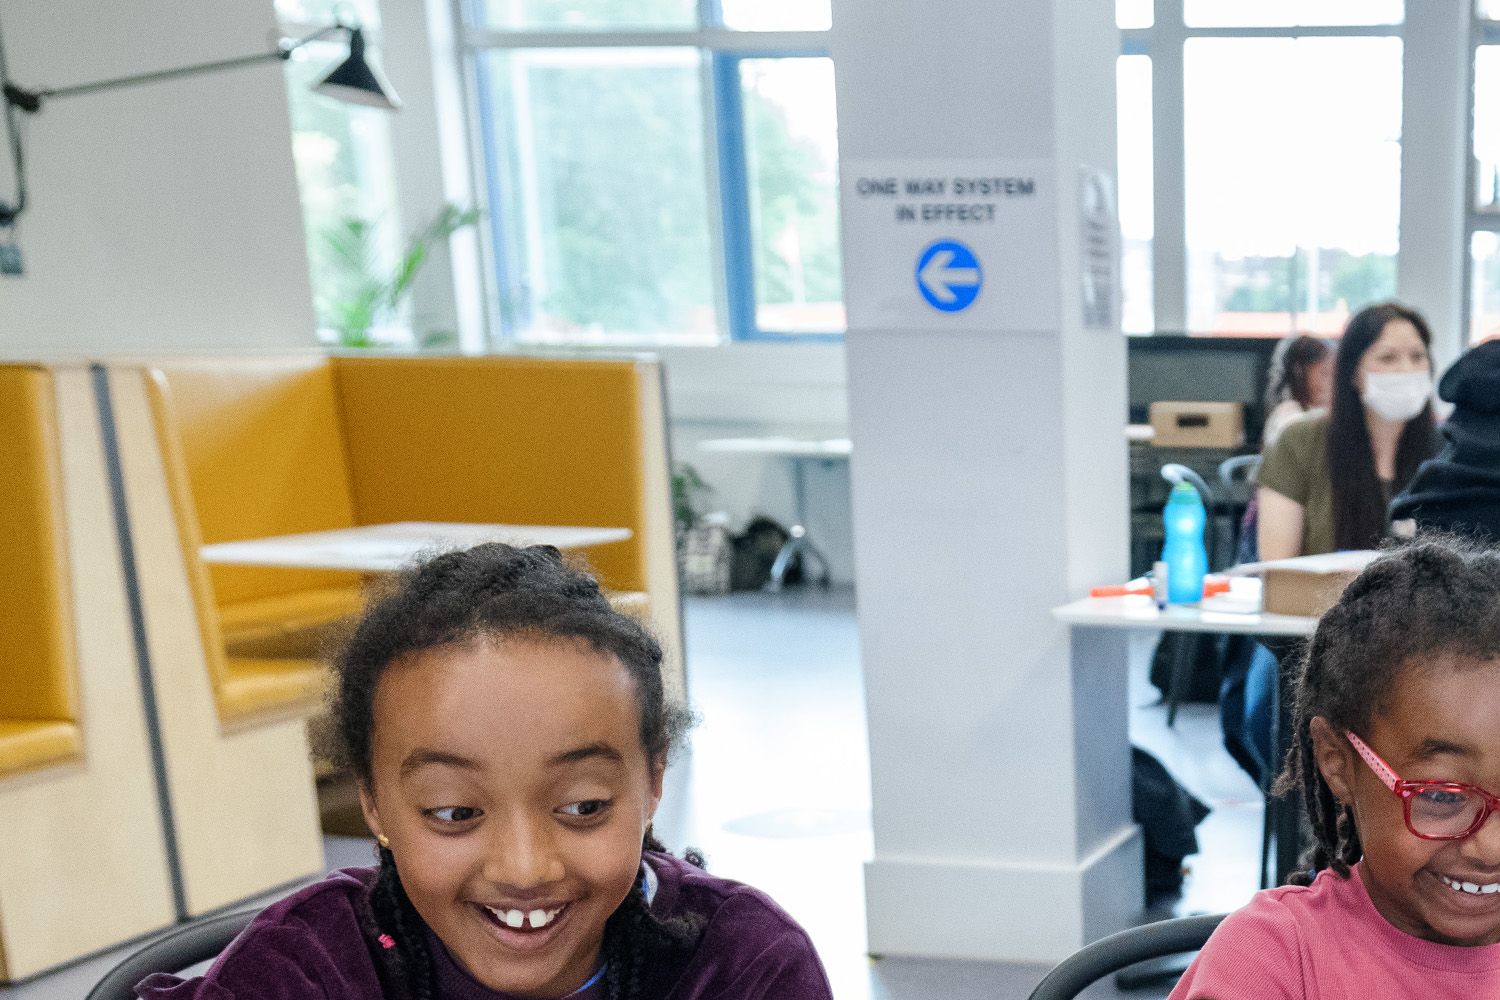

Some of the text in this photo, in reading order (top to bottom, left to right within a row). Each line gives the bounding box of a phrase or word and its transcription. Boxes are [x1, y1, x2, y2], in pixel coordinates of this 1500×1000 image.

[855, 177, 1035, 196] ONE WAY SYSTEM
[895, 204, 996, 222] IN EFFECT
